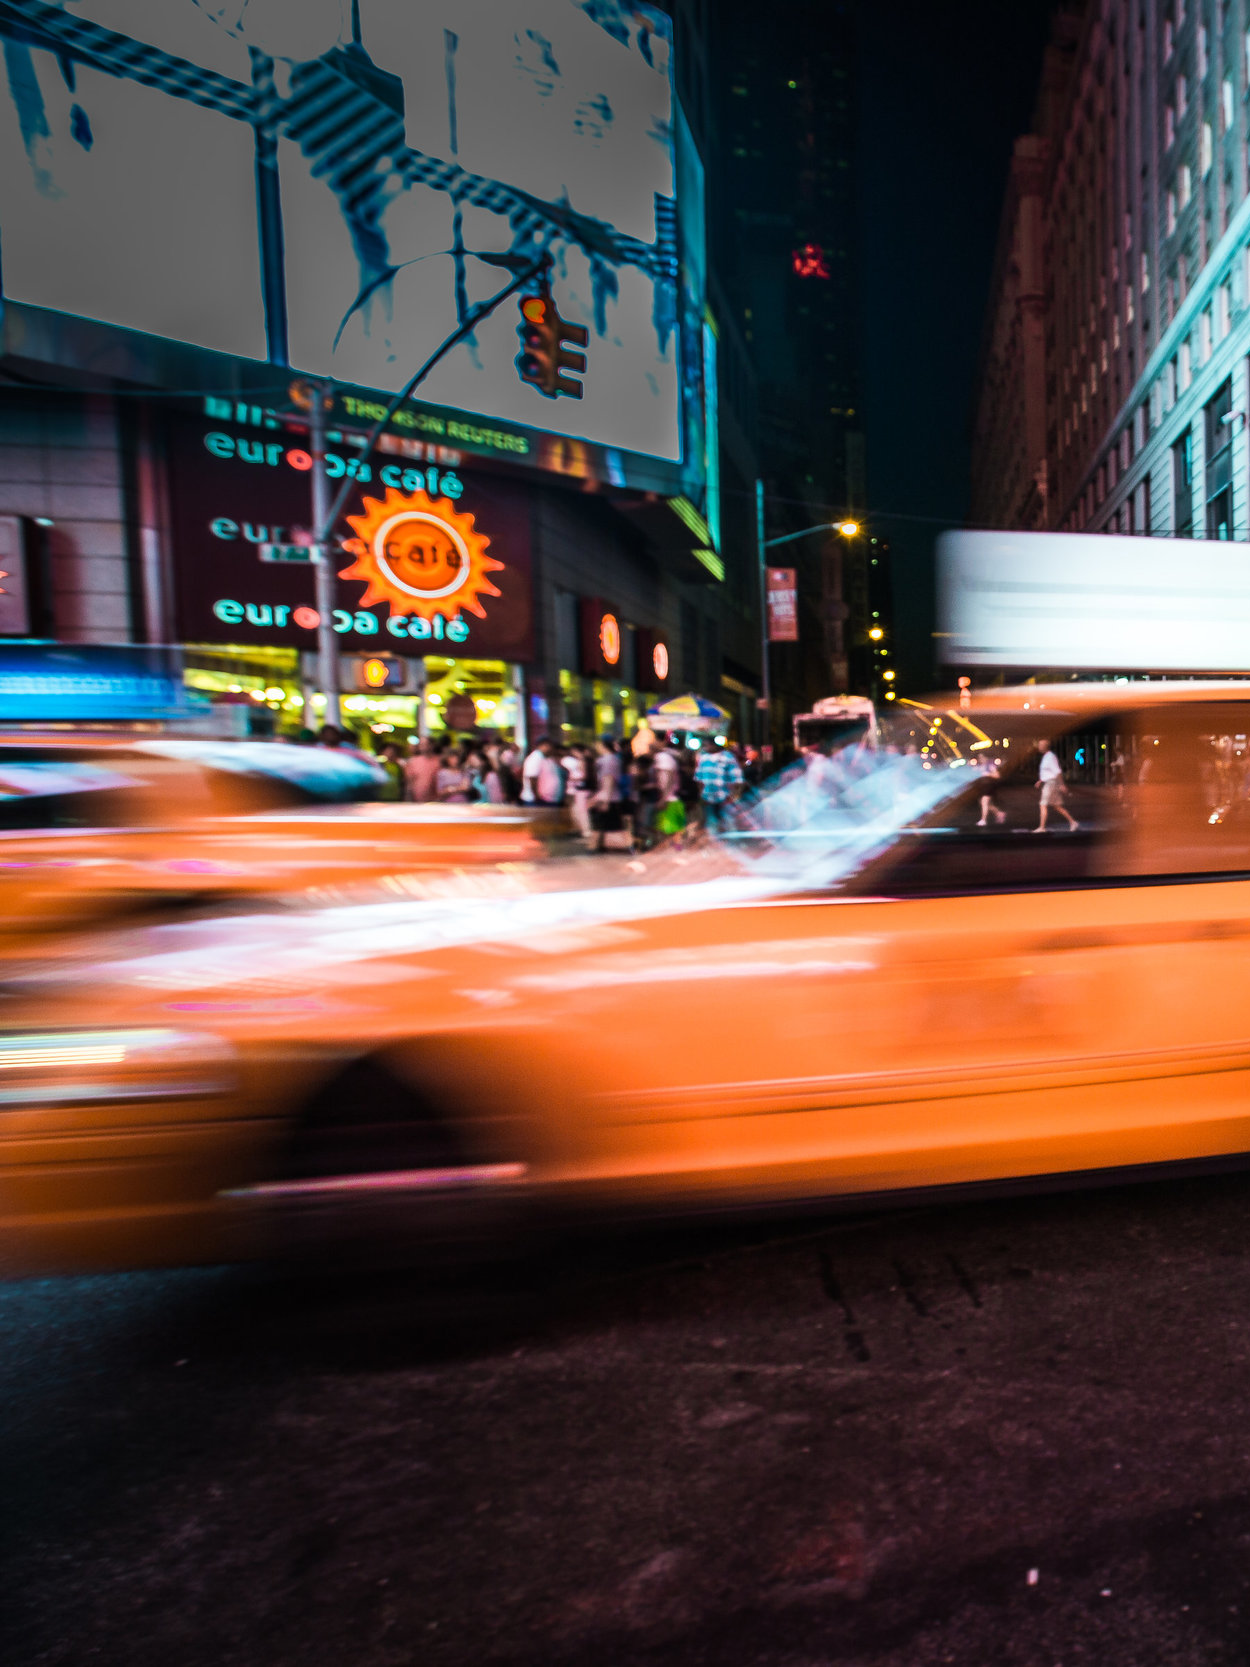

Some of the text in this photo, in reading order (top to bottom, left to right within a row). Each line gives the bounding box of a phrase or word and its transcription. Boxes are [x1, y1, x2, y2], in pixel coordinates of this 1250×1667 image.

[446, 420, 529, 455] REUTERS
[380, 464, 464, 500] café
[386, 613, 471, 644] café
